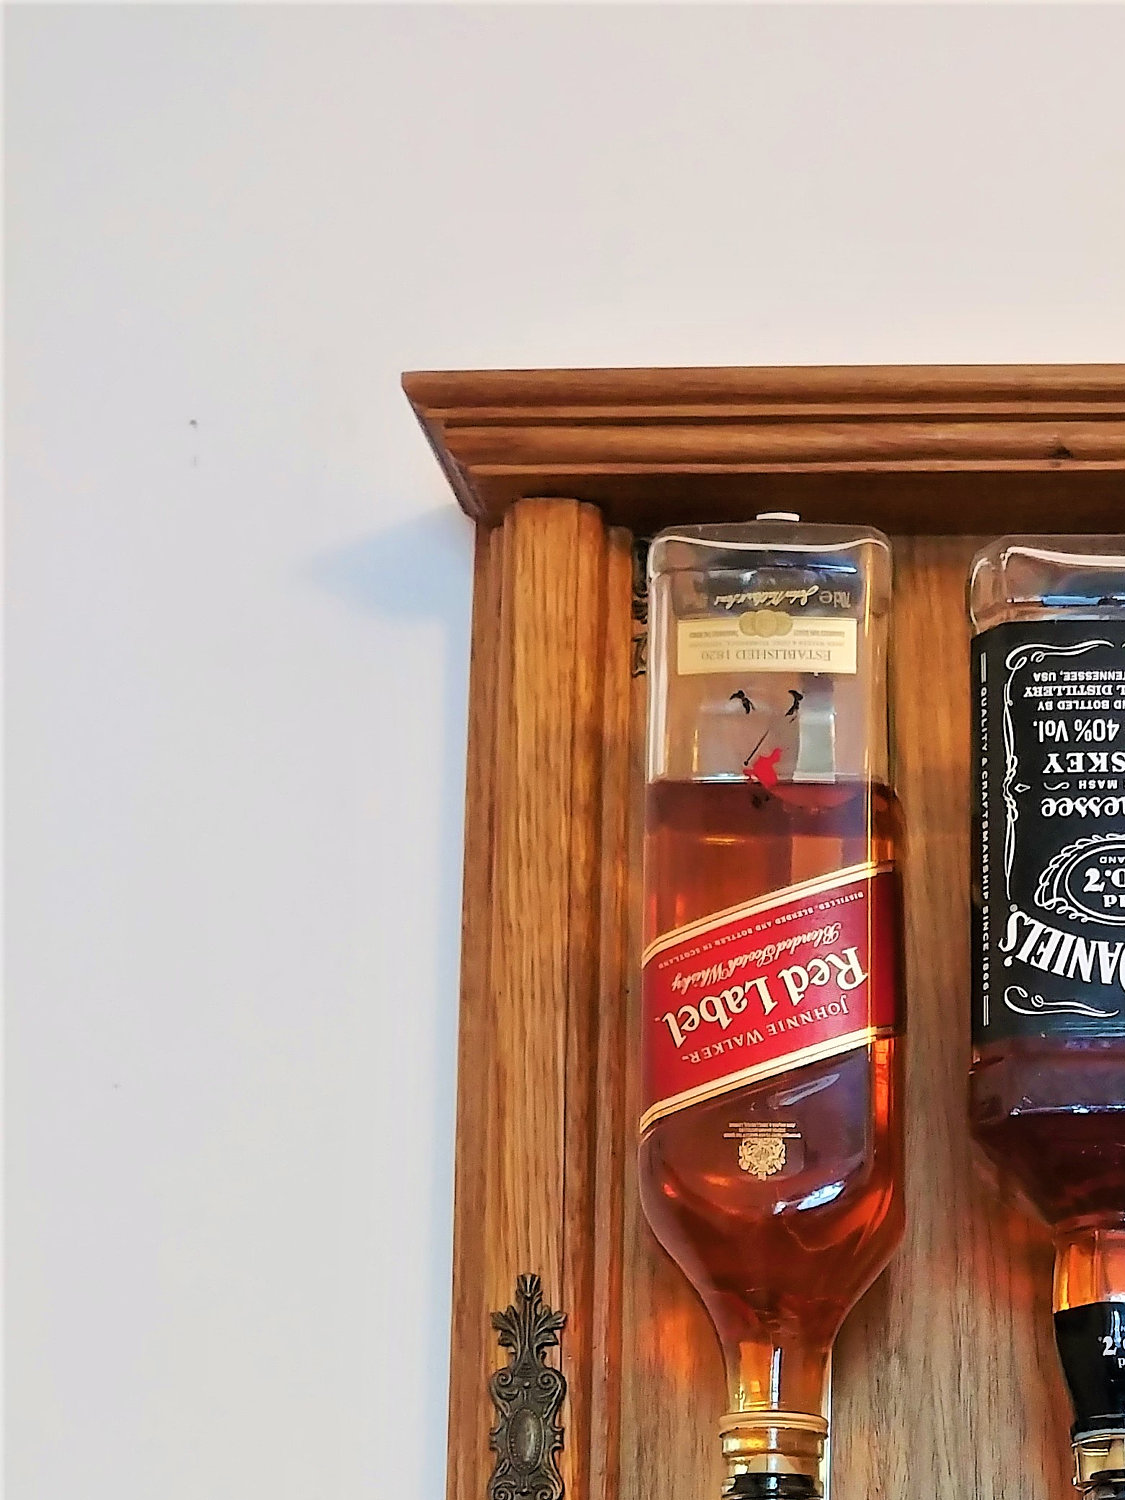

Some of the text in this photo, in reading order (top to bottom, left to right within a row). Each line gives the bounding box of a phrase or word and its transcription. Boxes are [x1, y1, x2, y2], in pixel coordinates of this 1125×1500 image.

[701, 649, 831, 662] ESTABLISHED 1820
[1033, 672, 1057, 682] USA
[1022, 684, 1113, 697] DISTILLERY
[1037, 701, 1054, 711] BY
[1057, 700, 1110, 710] BOTTLED
[980, 686, 989, 751] QUALITY
[1032, 719, 1069, 743] Vol.
[1074, 718, 1120, 742] 40%
[1078, 779, 1118, 790] MASH
[981, 770, 989, 901] CRAFTSMANSHIP
[774, 907, 814, 924] BLENDED
[755, 920, 772, 931] AND
[982, 905, 990, 952] SINCE
[714, 927, 753, 946] BOTTLED
[702, 942, 713, 951] IN
[658, 947, 701, 969] SCOTLAND
[671, 922, 842, 995] Blended Scotch Whisky
[662, 946, 868, 1048] Red Label
[687, 994, 849, 1063] JOHNNIE WALKER
